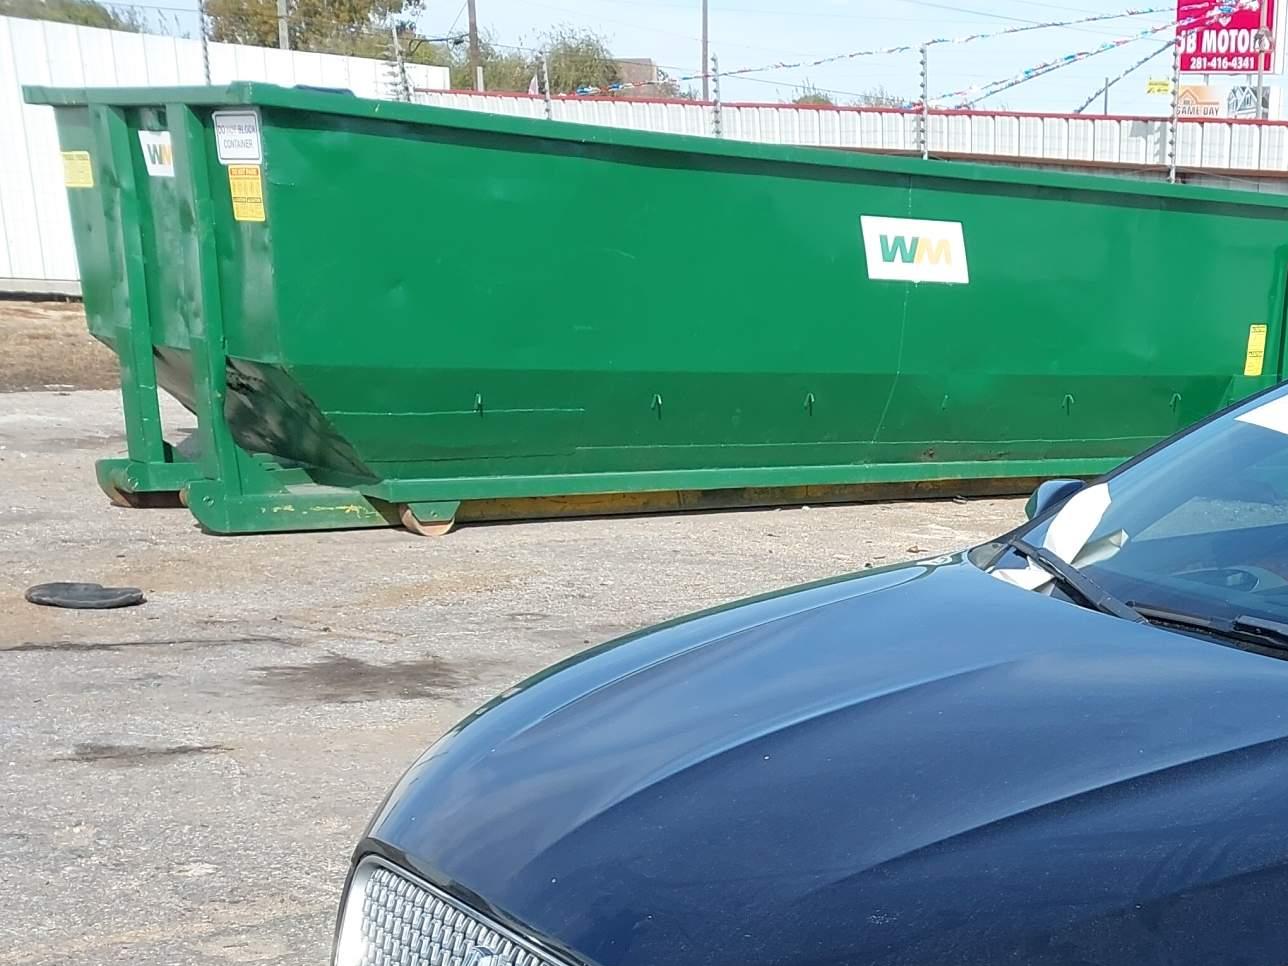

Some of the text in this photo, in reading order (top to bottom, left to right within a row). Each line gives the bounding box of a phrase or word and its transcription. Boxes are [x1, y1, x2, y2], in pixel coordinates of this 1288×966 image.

[1189, 56, 1255, 69] 281-416-4341
[1203, 106, 1219, 116] DAY
[879, 234, 953, 265] WM
